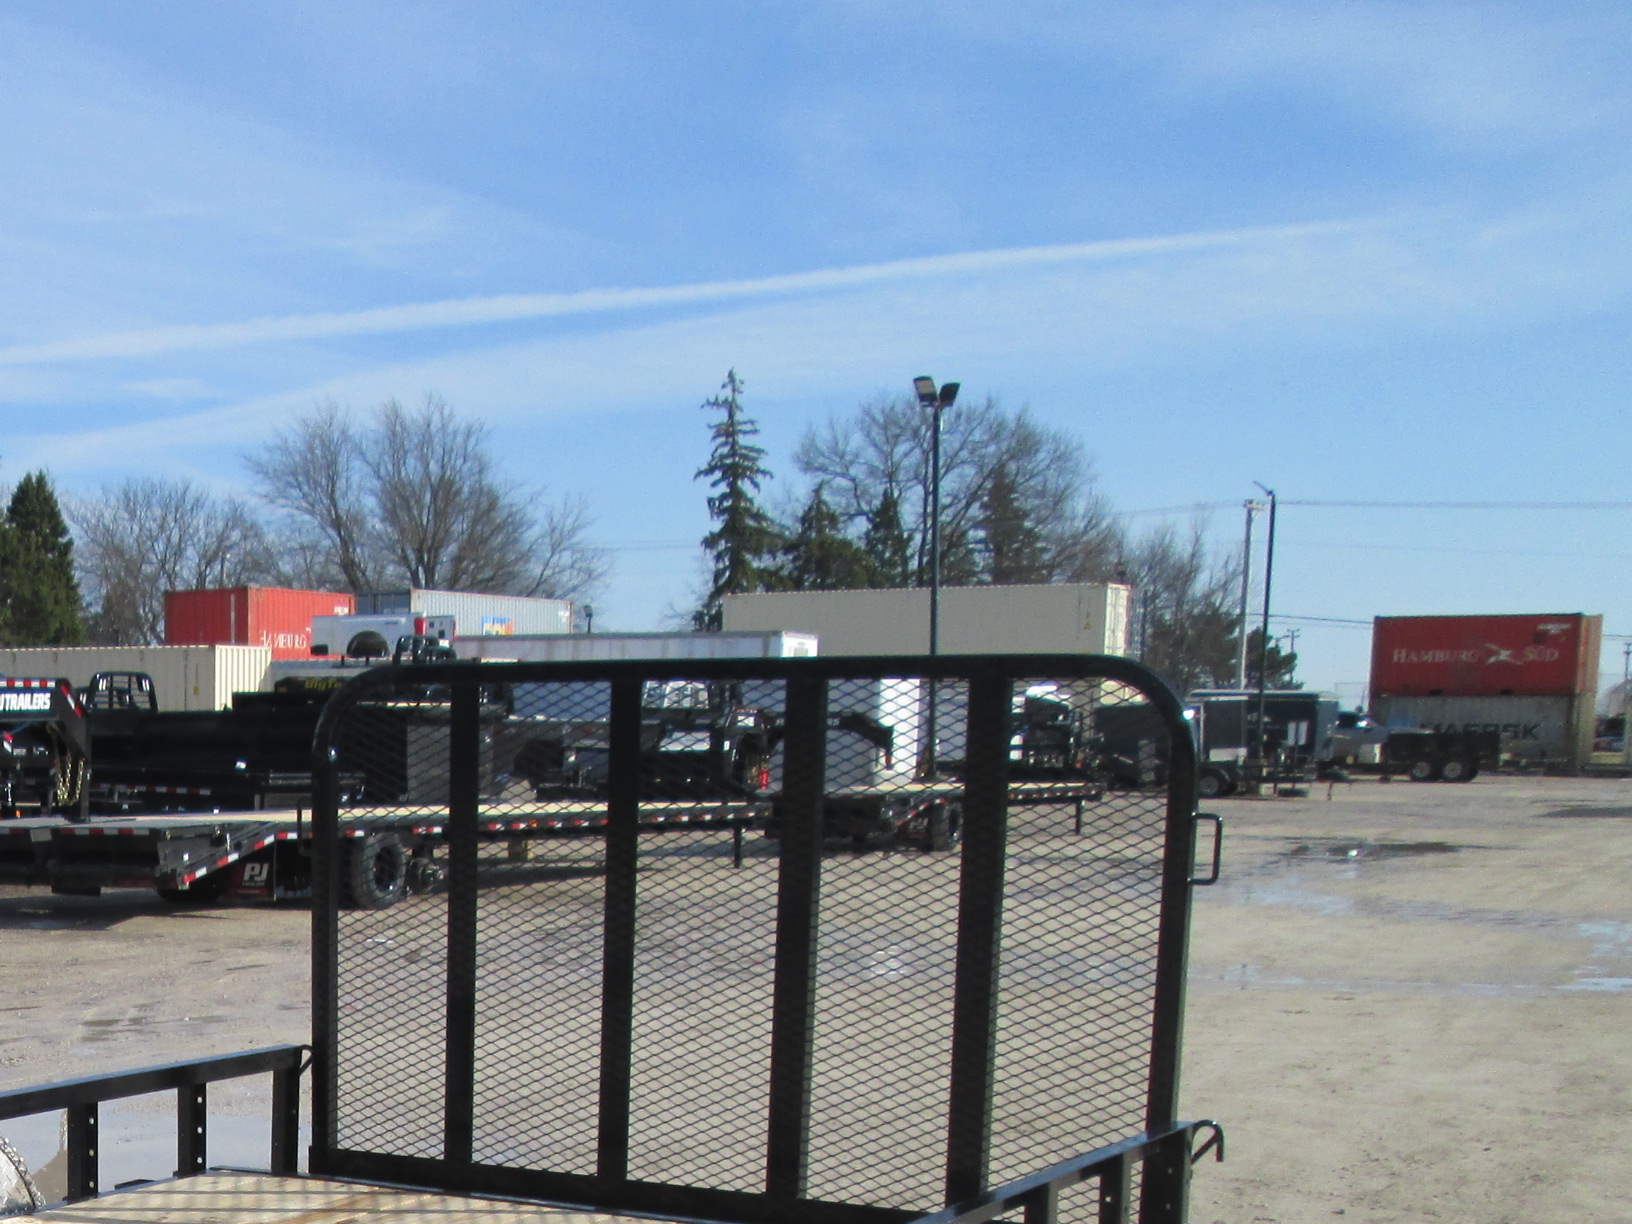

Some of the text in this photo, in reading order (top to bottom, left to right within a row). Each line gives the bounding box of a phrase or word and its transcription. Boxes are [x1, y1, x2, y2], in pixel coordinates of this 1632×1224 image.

[1392, 649, 1478, 663] HAMBURG
[5, 693, 51, 710] TRAILERS
[243, 863, 269, 880] PJ
